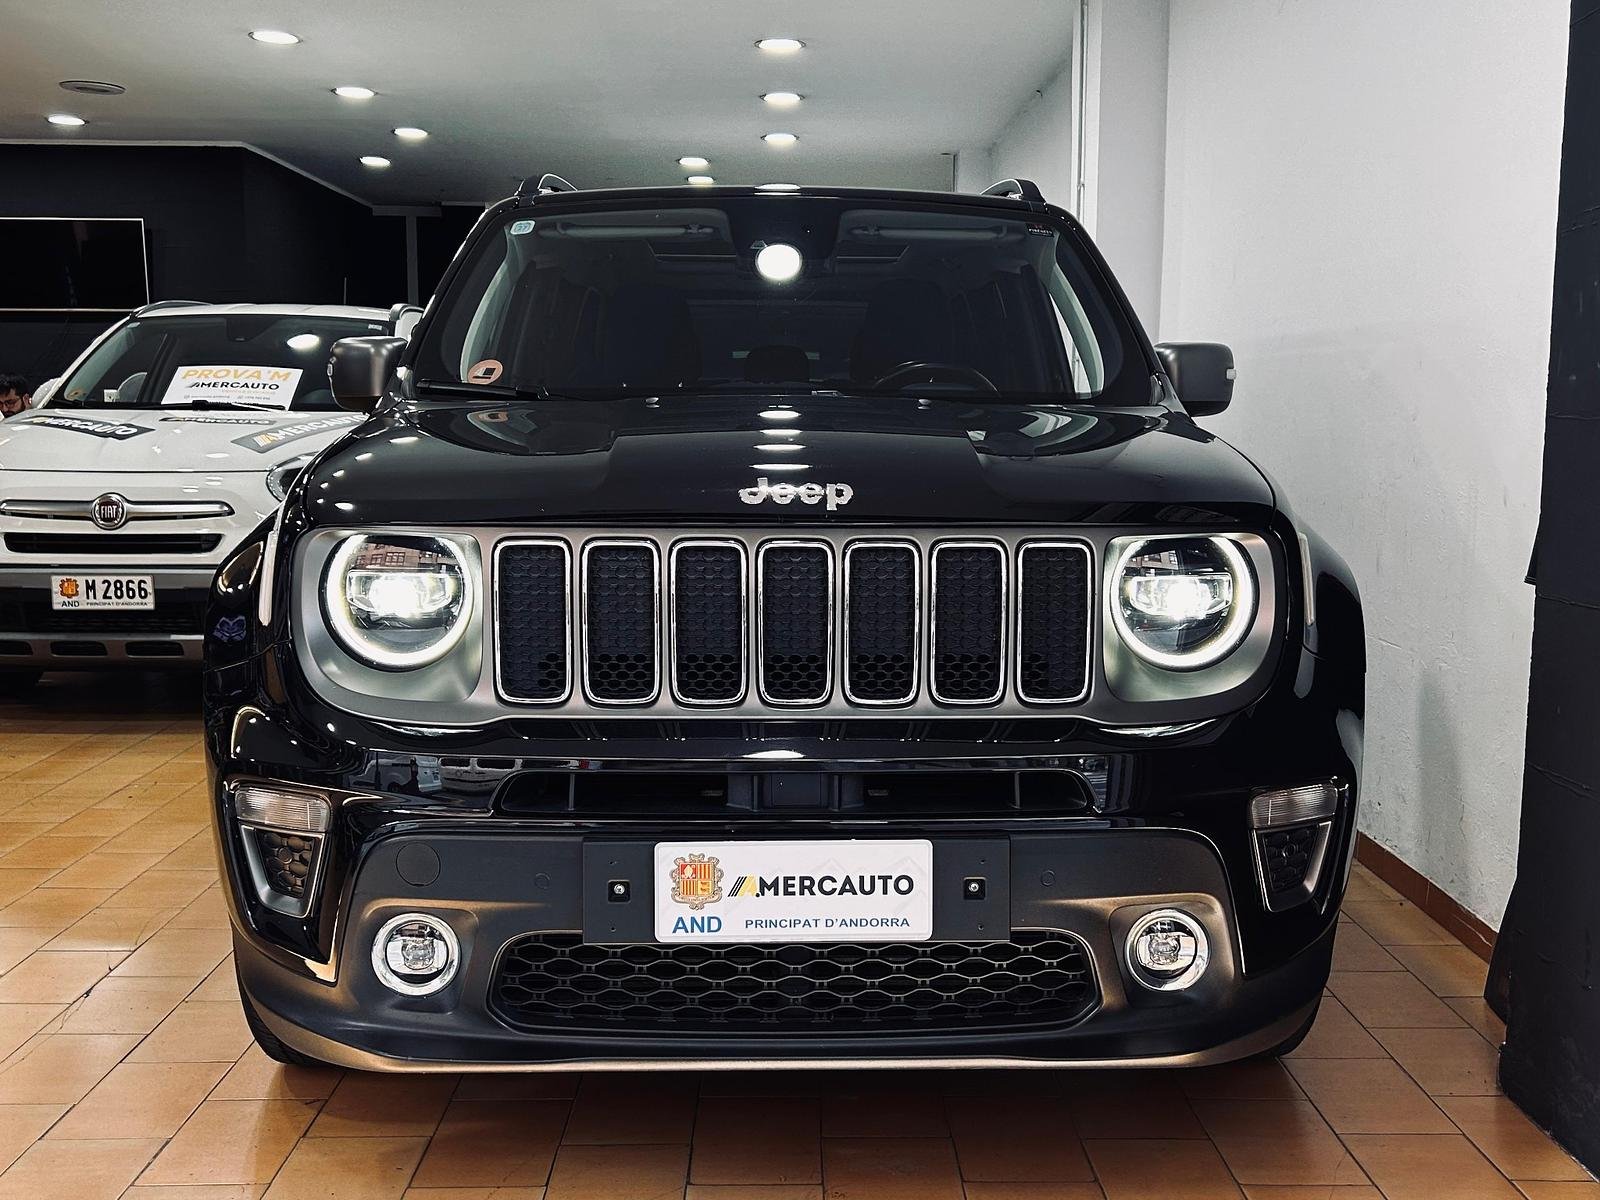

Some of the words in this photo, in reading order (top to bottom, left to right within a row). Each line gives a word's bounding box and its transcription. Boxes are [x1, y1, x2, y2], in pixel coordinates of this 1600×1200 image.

[738, 477, 854, 511] Jeep
[101, 505, 118, 519] FIAT
[85, 579, 97, 600] M
[102, 579, 149, 600] 2866
[61, 600, 80, 608] AND
[672, 916, 722, 934] AND
[745, 918, 820, 929] PRINCIPAT
[825, 917, 910, 928] D'ANDORRA
